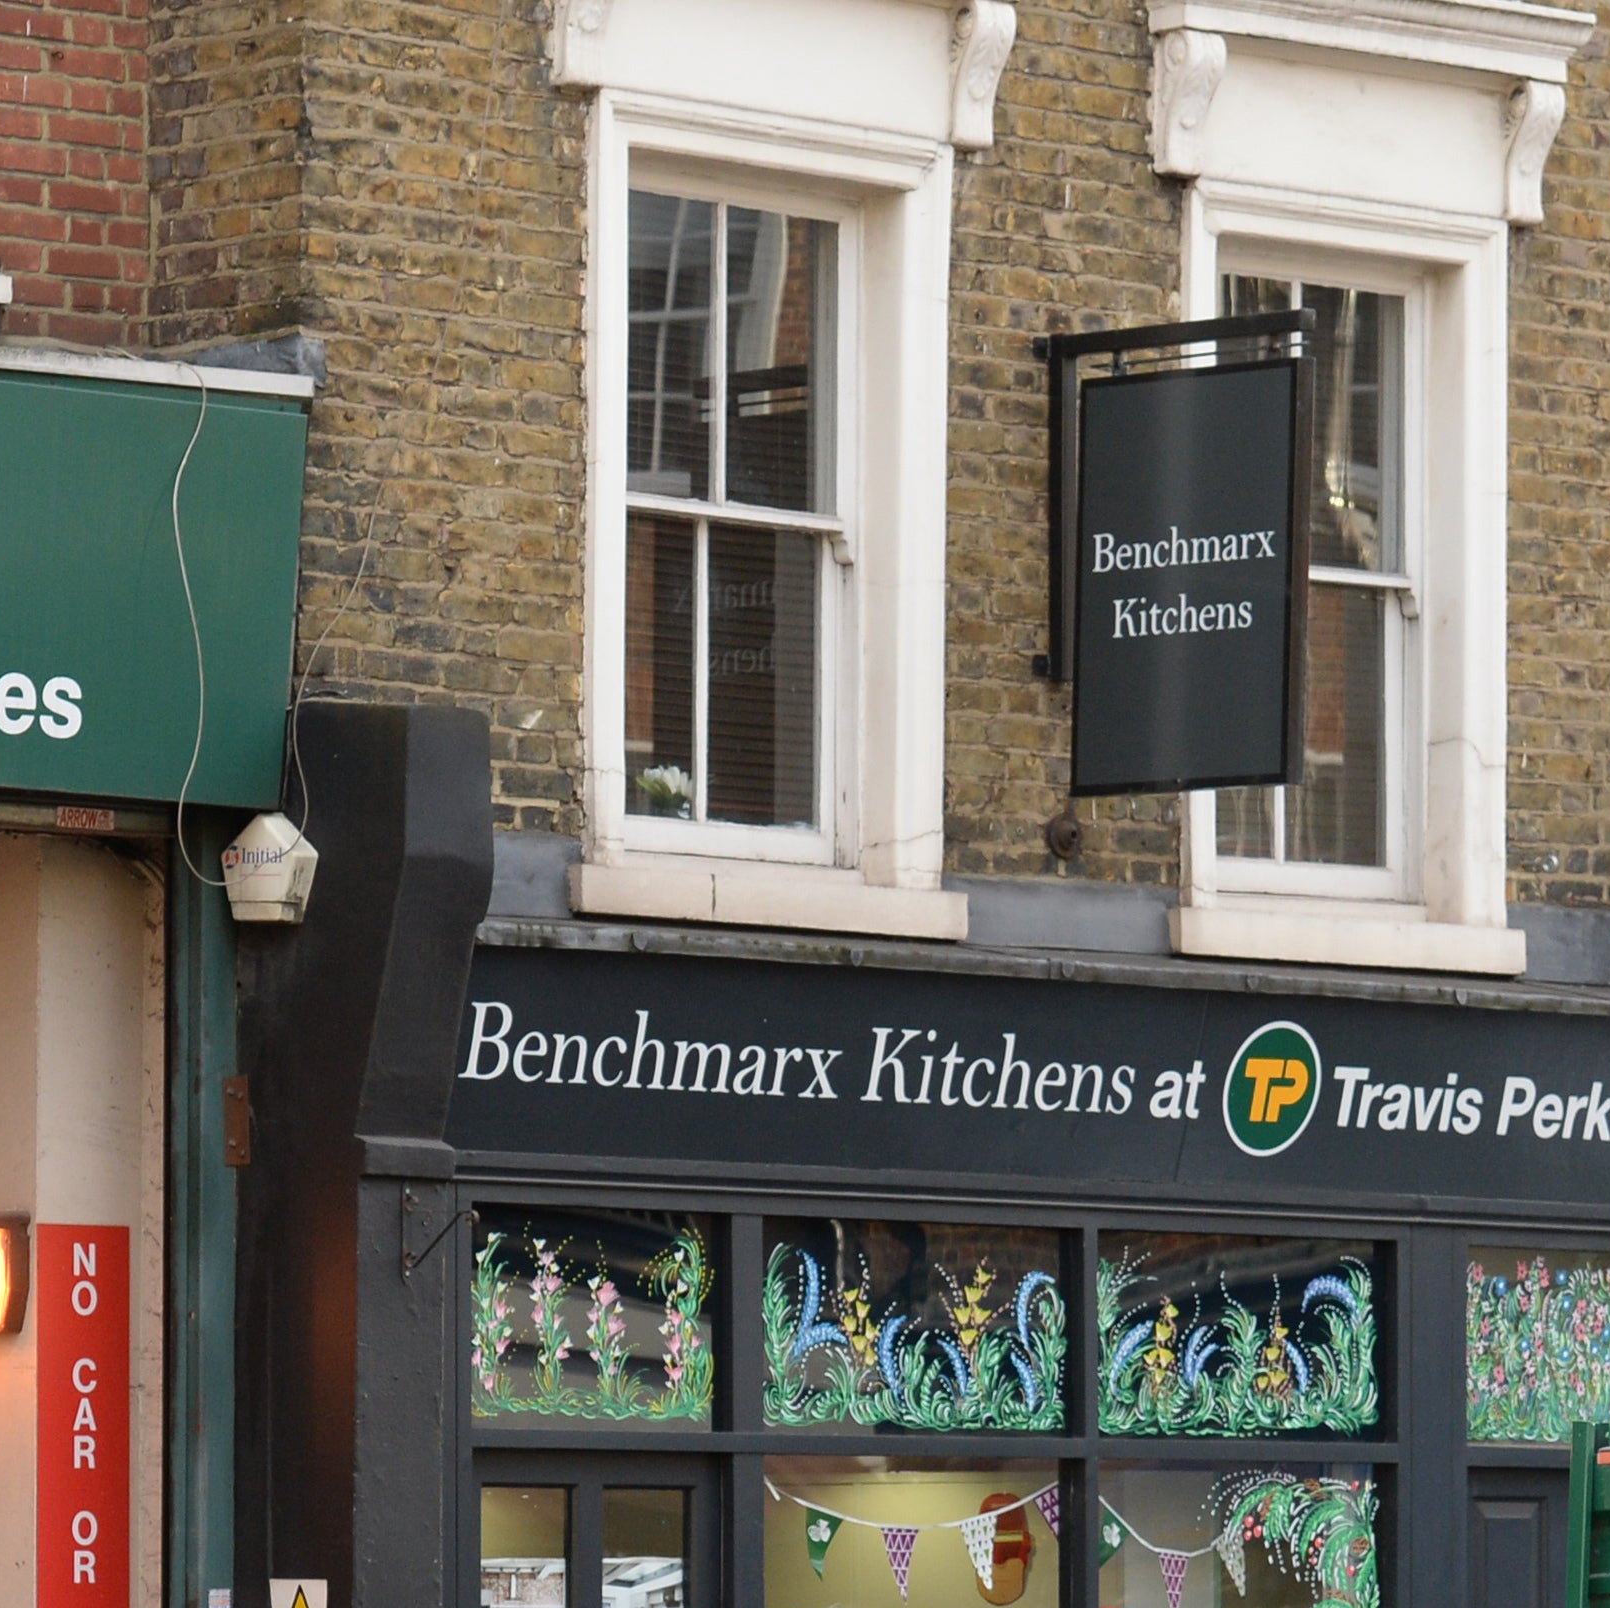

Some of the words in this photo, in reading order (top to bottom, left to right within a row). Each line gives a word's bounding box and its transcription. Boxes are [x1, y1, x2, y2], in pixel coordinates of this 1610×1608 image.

[1092, 526, 1276, 573] Benchmarx
[1112, 594, 1253, 638] Kitchens
[60, 808, 97, 829] ARROW
[242, 847, 283, 863] Initial
[458, 1001, 842, 1101] Benchmarx
[863, 1027, 1135, 1116] Kitchens
[1148, 1058, 1206, 1120] at
[1242, 1056, 1308, 1122] TP
[1334, 1066, 1483, 1136] Travis
[70, 1242, 98, 1317] NO
[70, 1357, 98, 1470] CAR
[70, 1509, 98, 1585] OR
